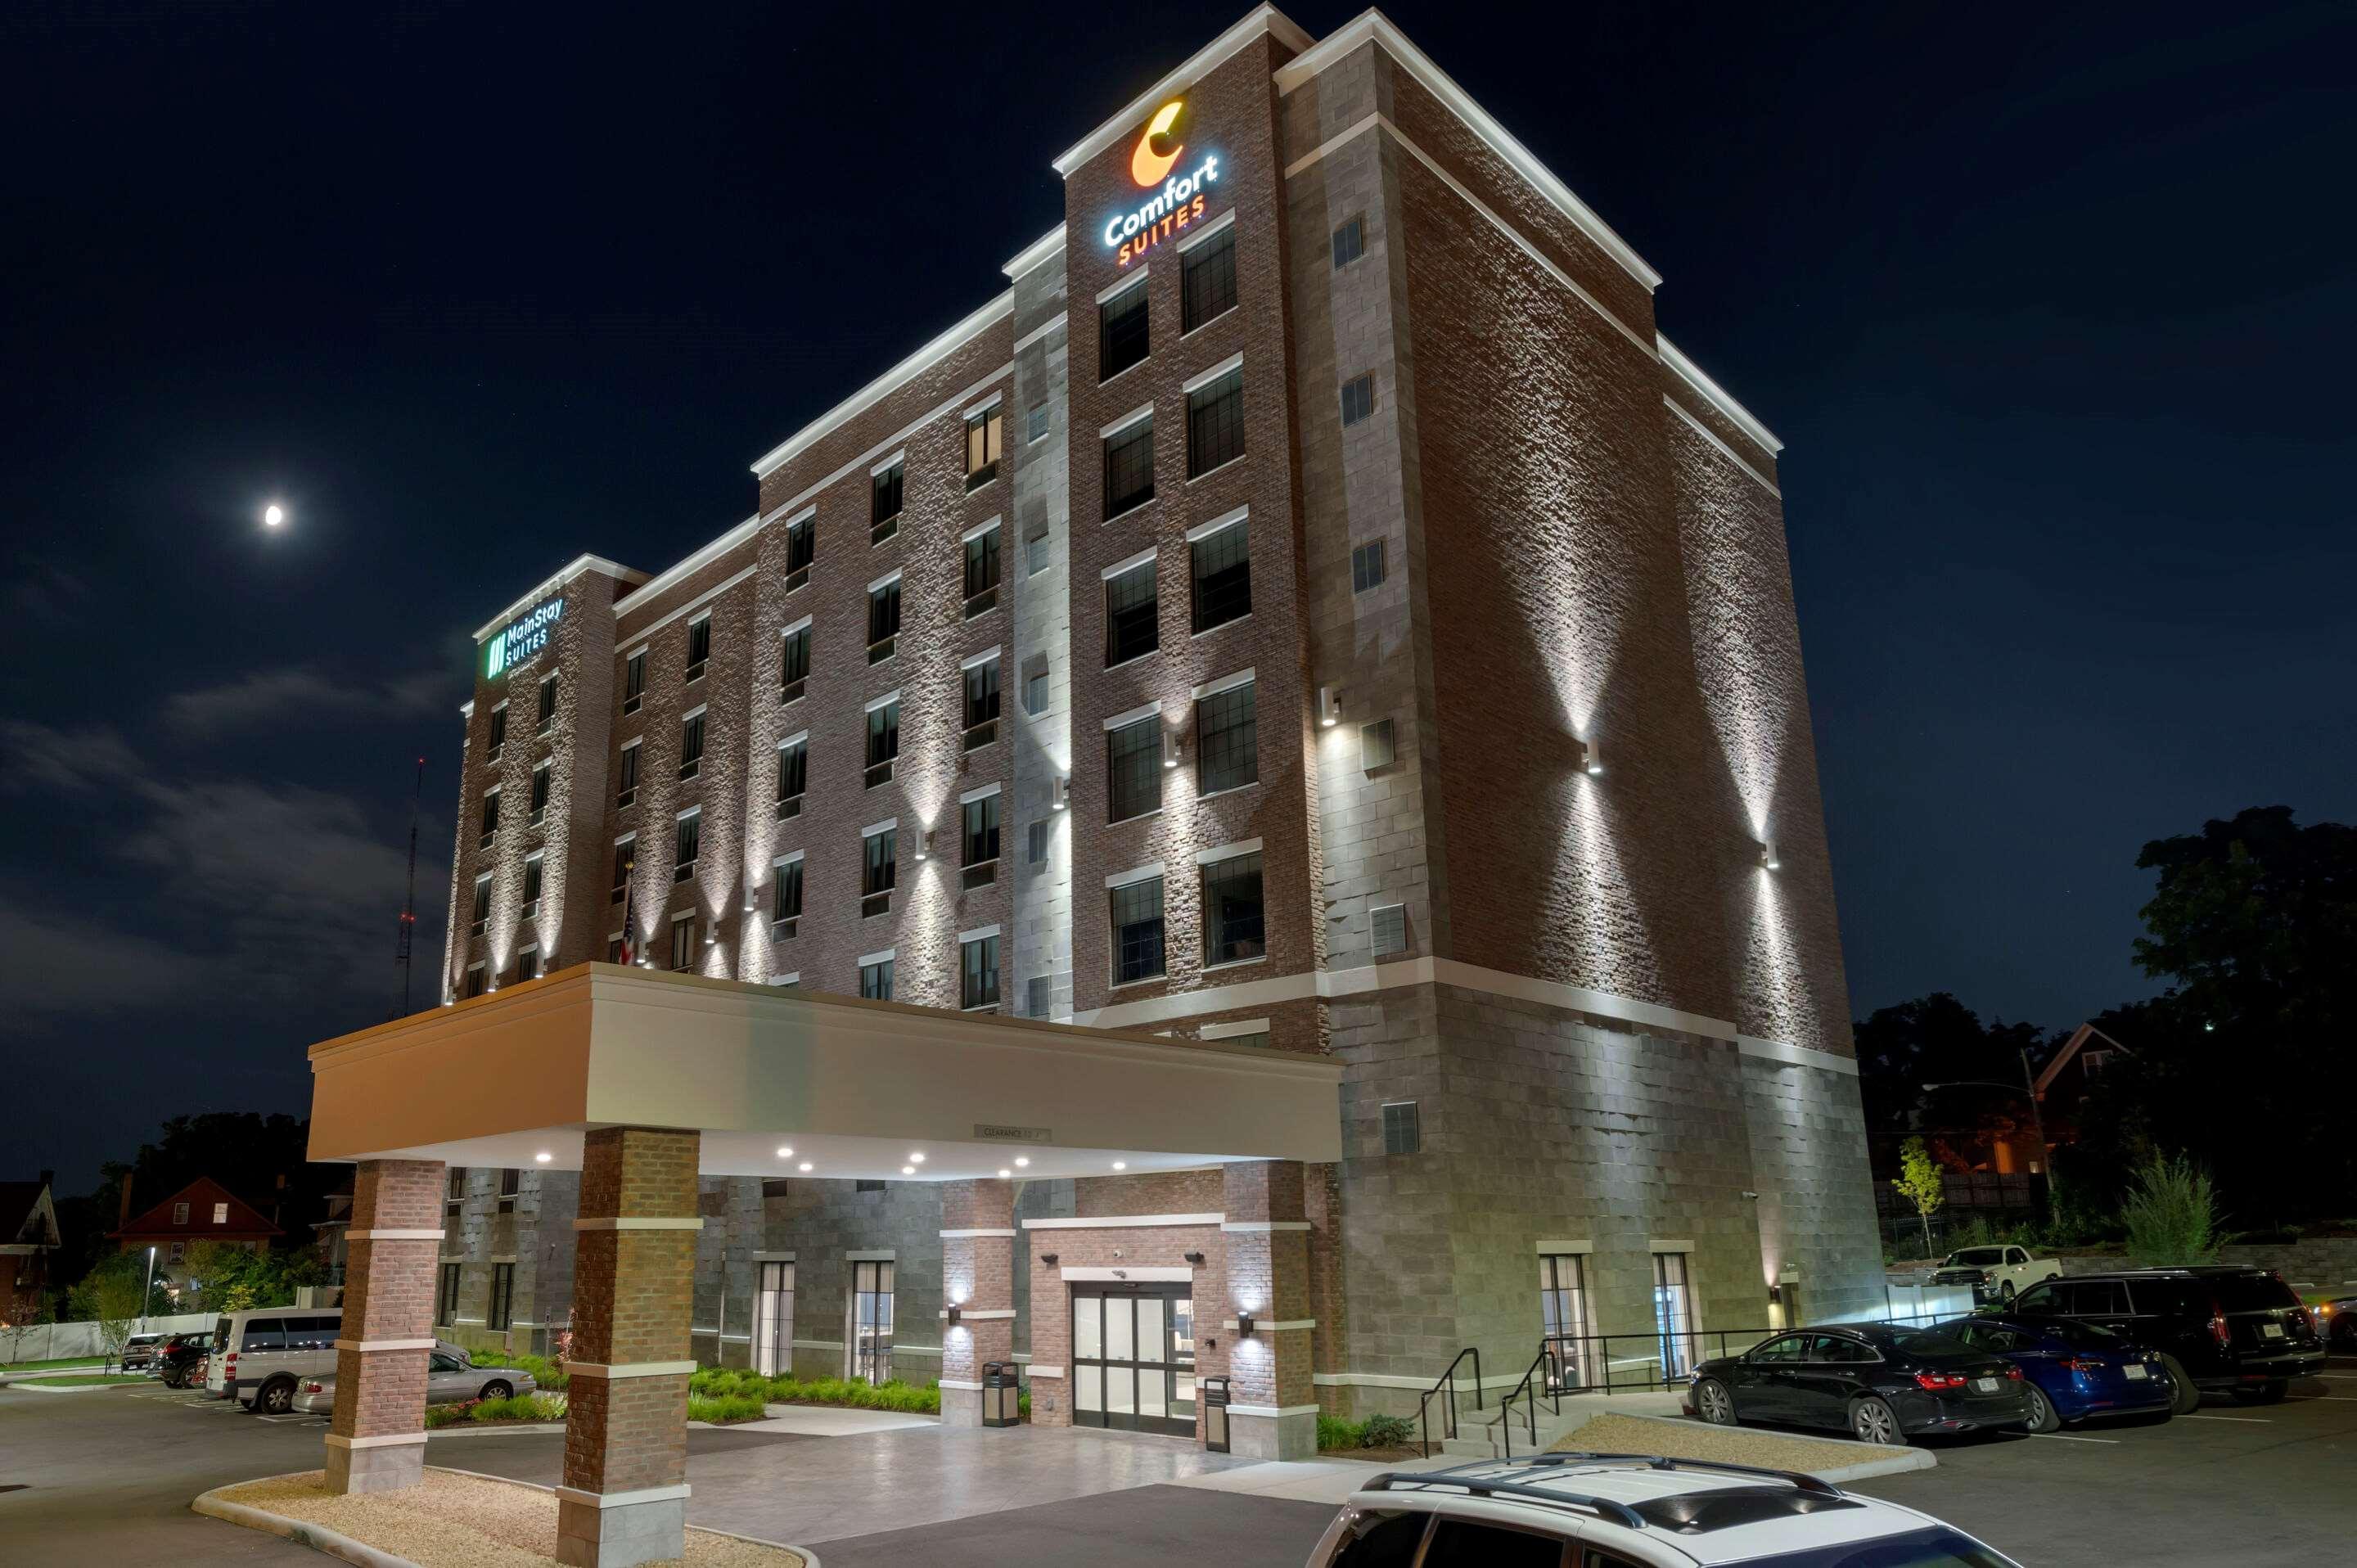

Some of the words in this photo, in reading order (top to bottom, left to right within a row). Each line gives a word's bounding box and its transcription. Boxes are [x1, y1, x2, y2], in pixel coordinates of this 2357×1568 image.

[1105, 155, 1218, 246] Comfort
[1119, 195, 1205, 264] SUITES
[506, 629, 547, 666] SUITES
[507, 598, 563, 647] MainStay
